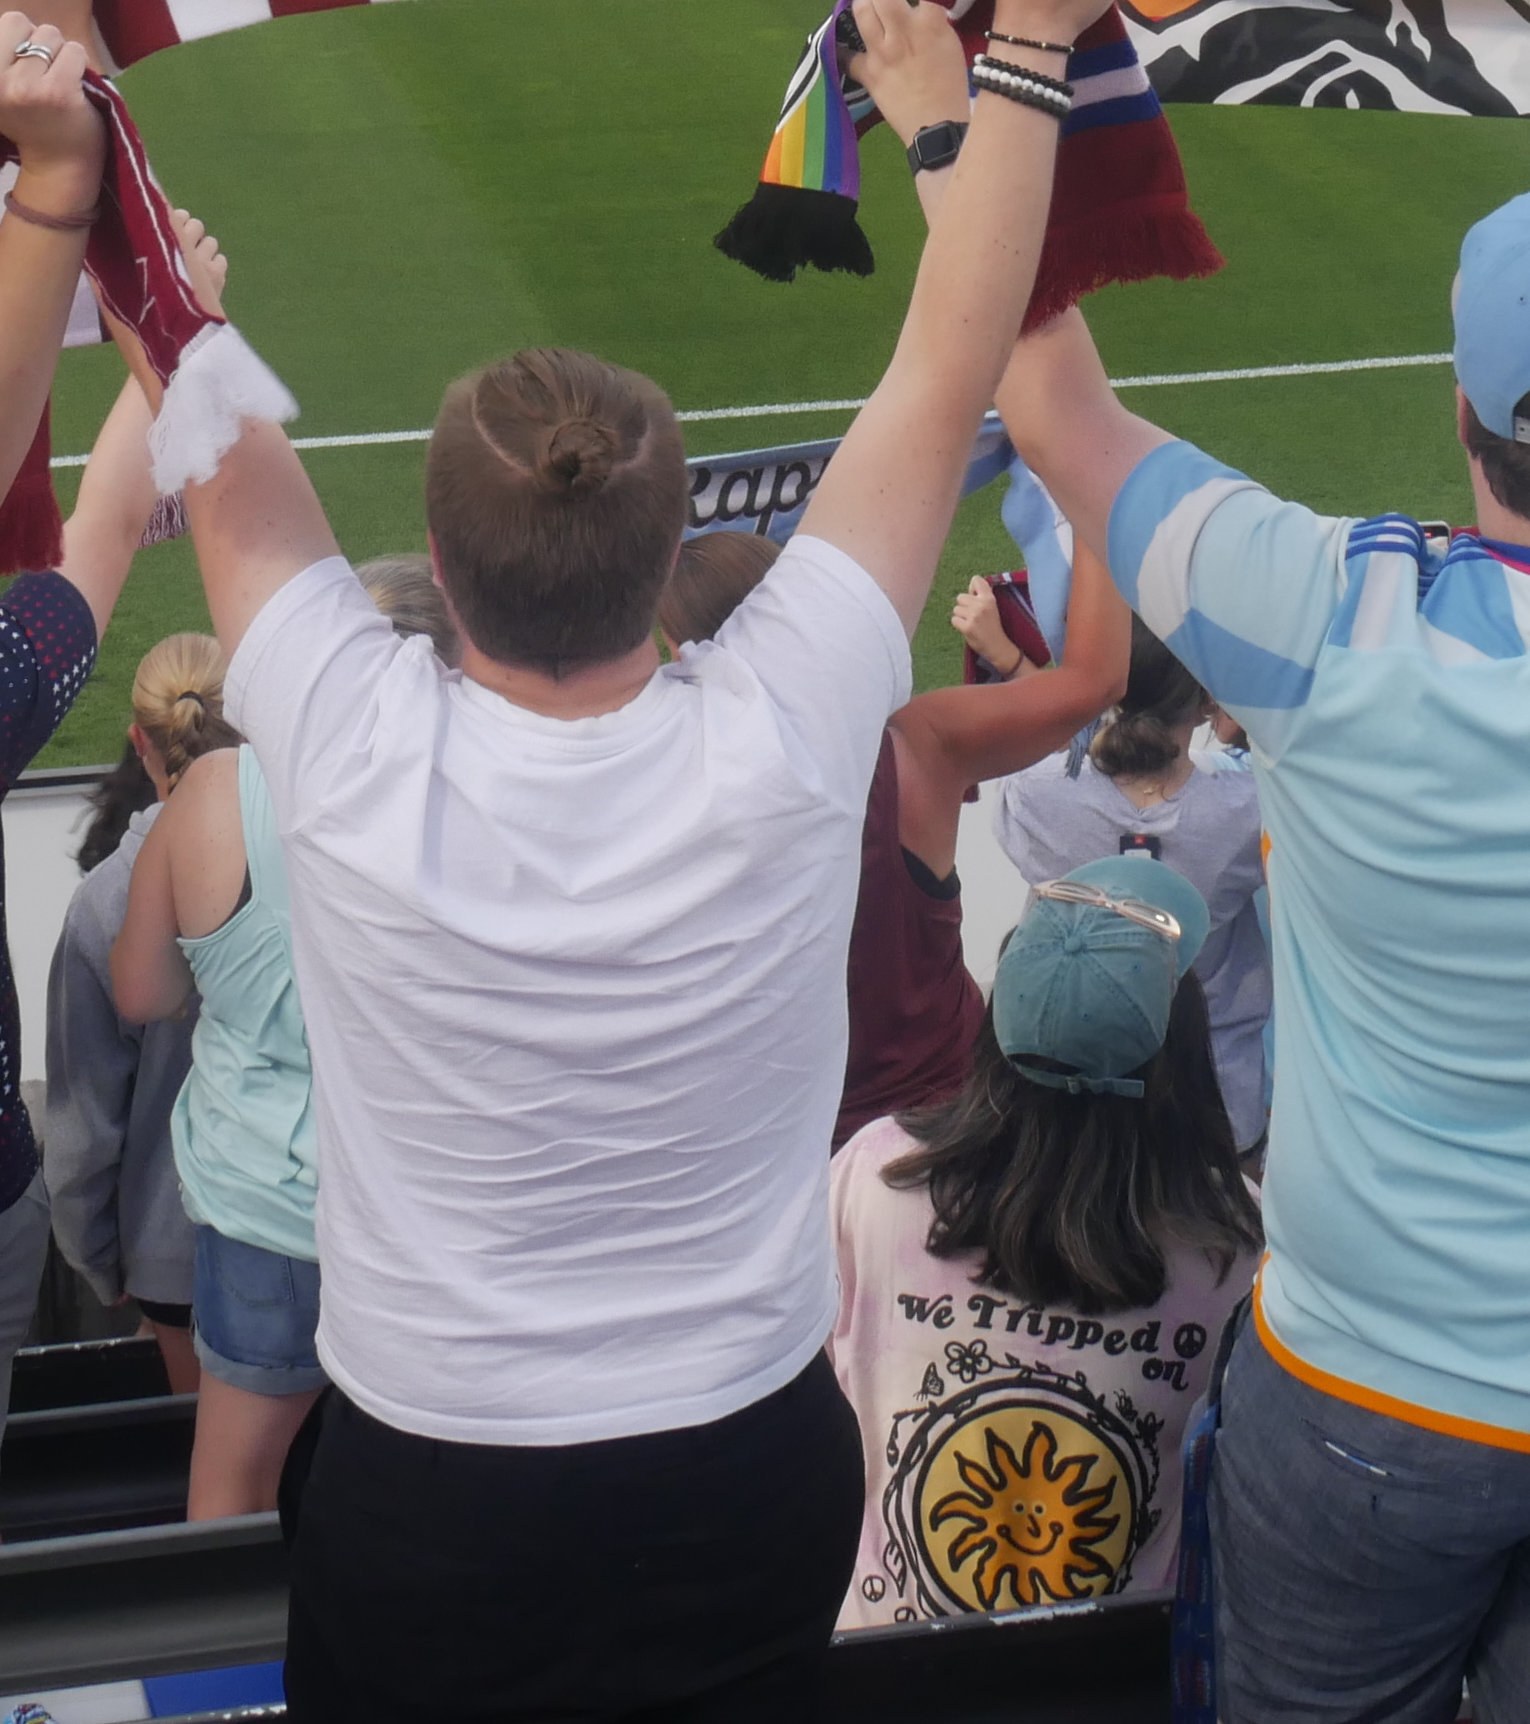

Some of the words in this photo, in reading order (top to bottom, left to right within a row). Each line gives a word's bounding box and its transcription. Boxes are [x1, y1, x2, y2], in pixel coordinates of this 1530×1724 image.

[897, 1293, 955, 1329] We
[967, 1293, 1163, 1356] Tripped
[1141, 1357, 1189, 1392] on
